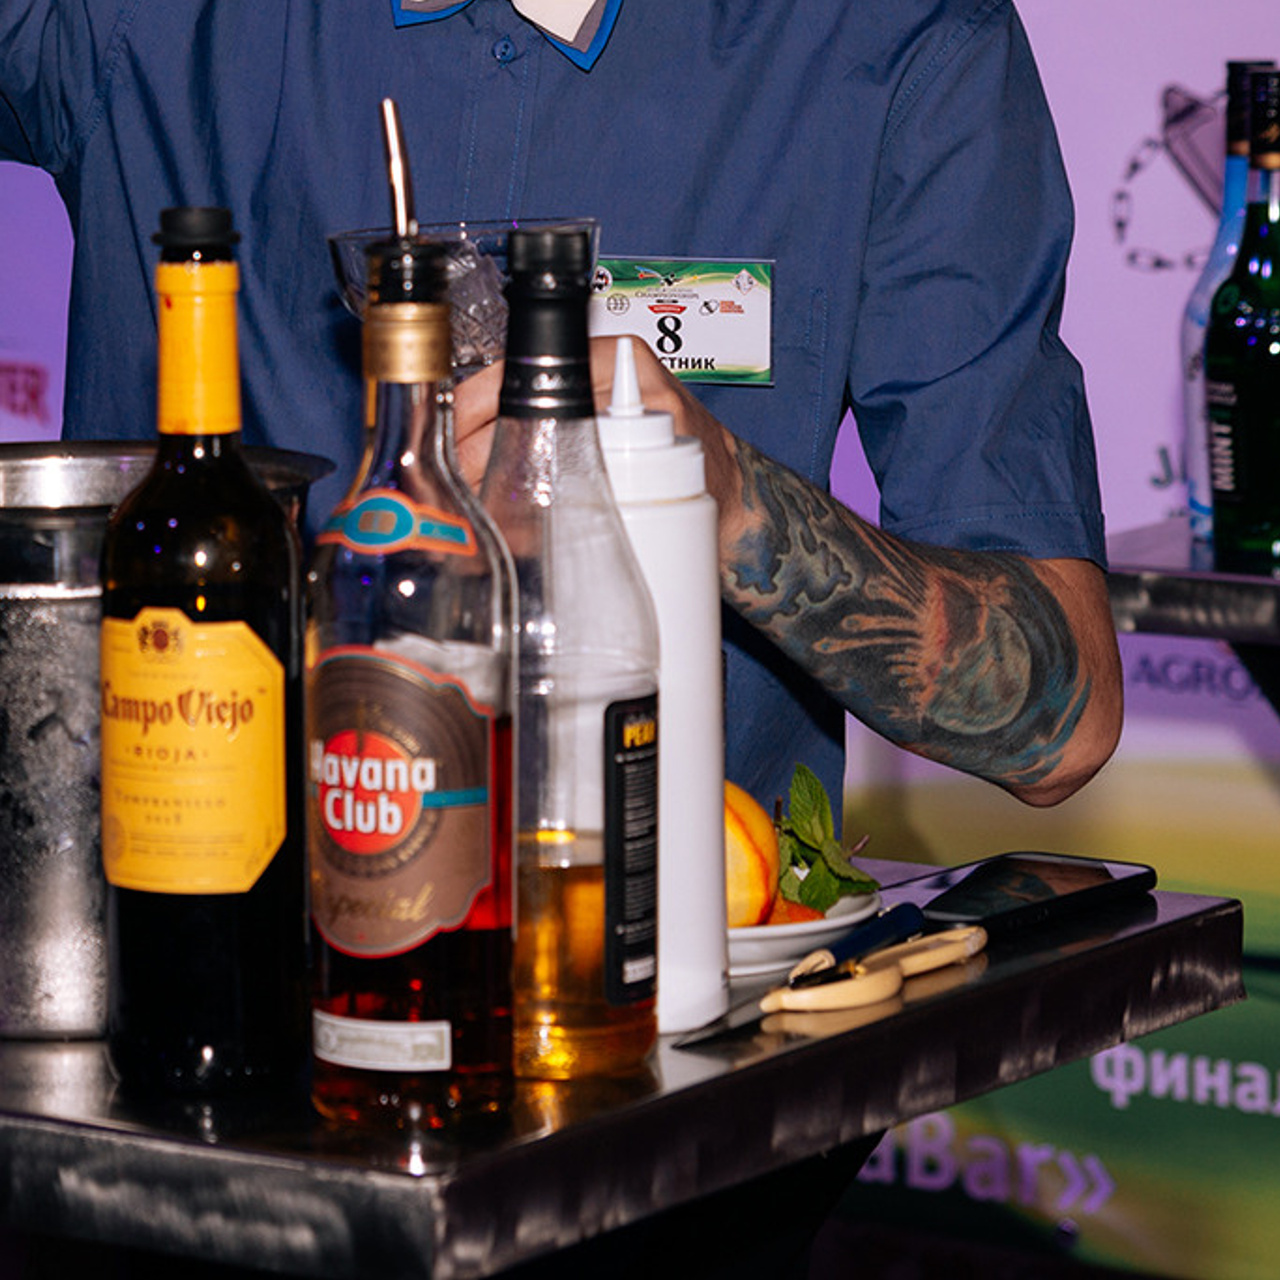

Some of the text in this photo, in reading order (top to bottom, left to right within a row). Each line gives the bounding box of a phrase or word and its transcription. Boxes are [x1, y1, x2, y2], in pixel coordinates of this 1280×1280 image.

[655, 315, 683, 355] 8
[103, 680, 255, 742] Campo Viejo
[309, 738, 437, 794] Havana
[324, 787, 403, 835] Club
[1091, 1043, 1280, 1118] фина
